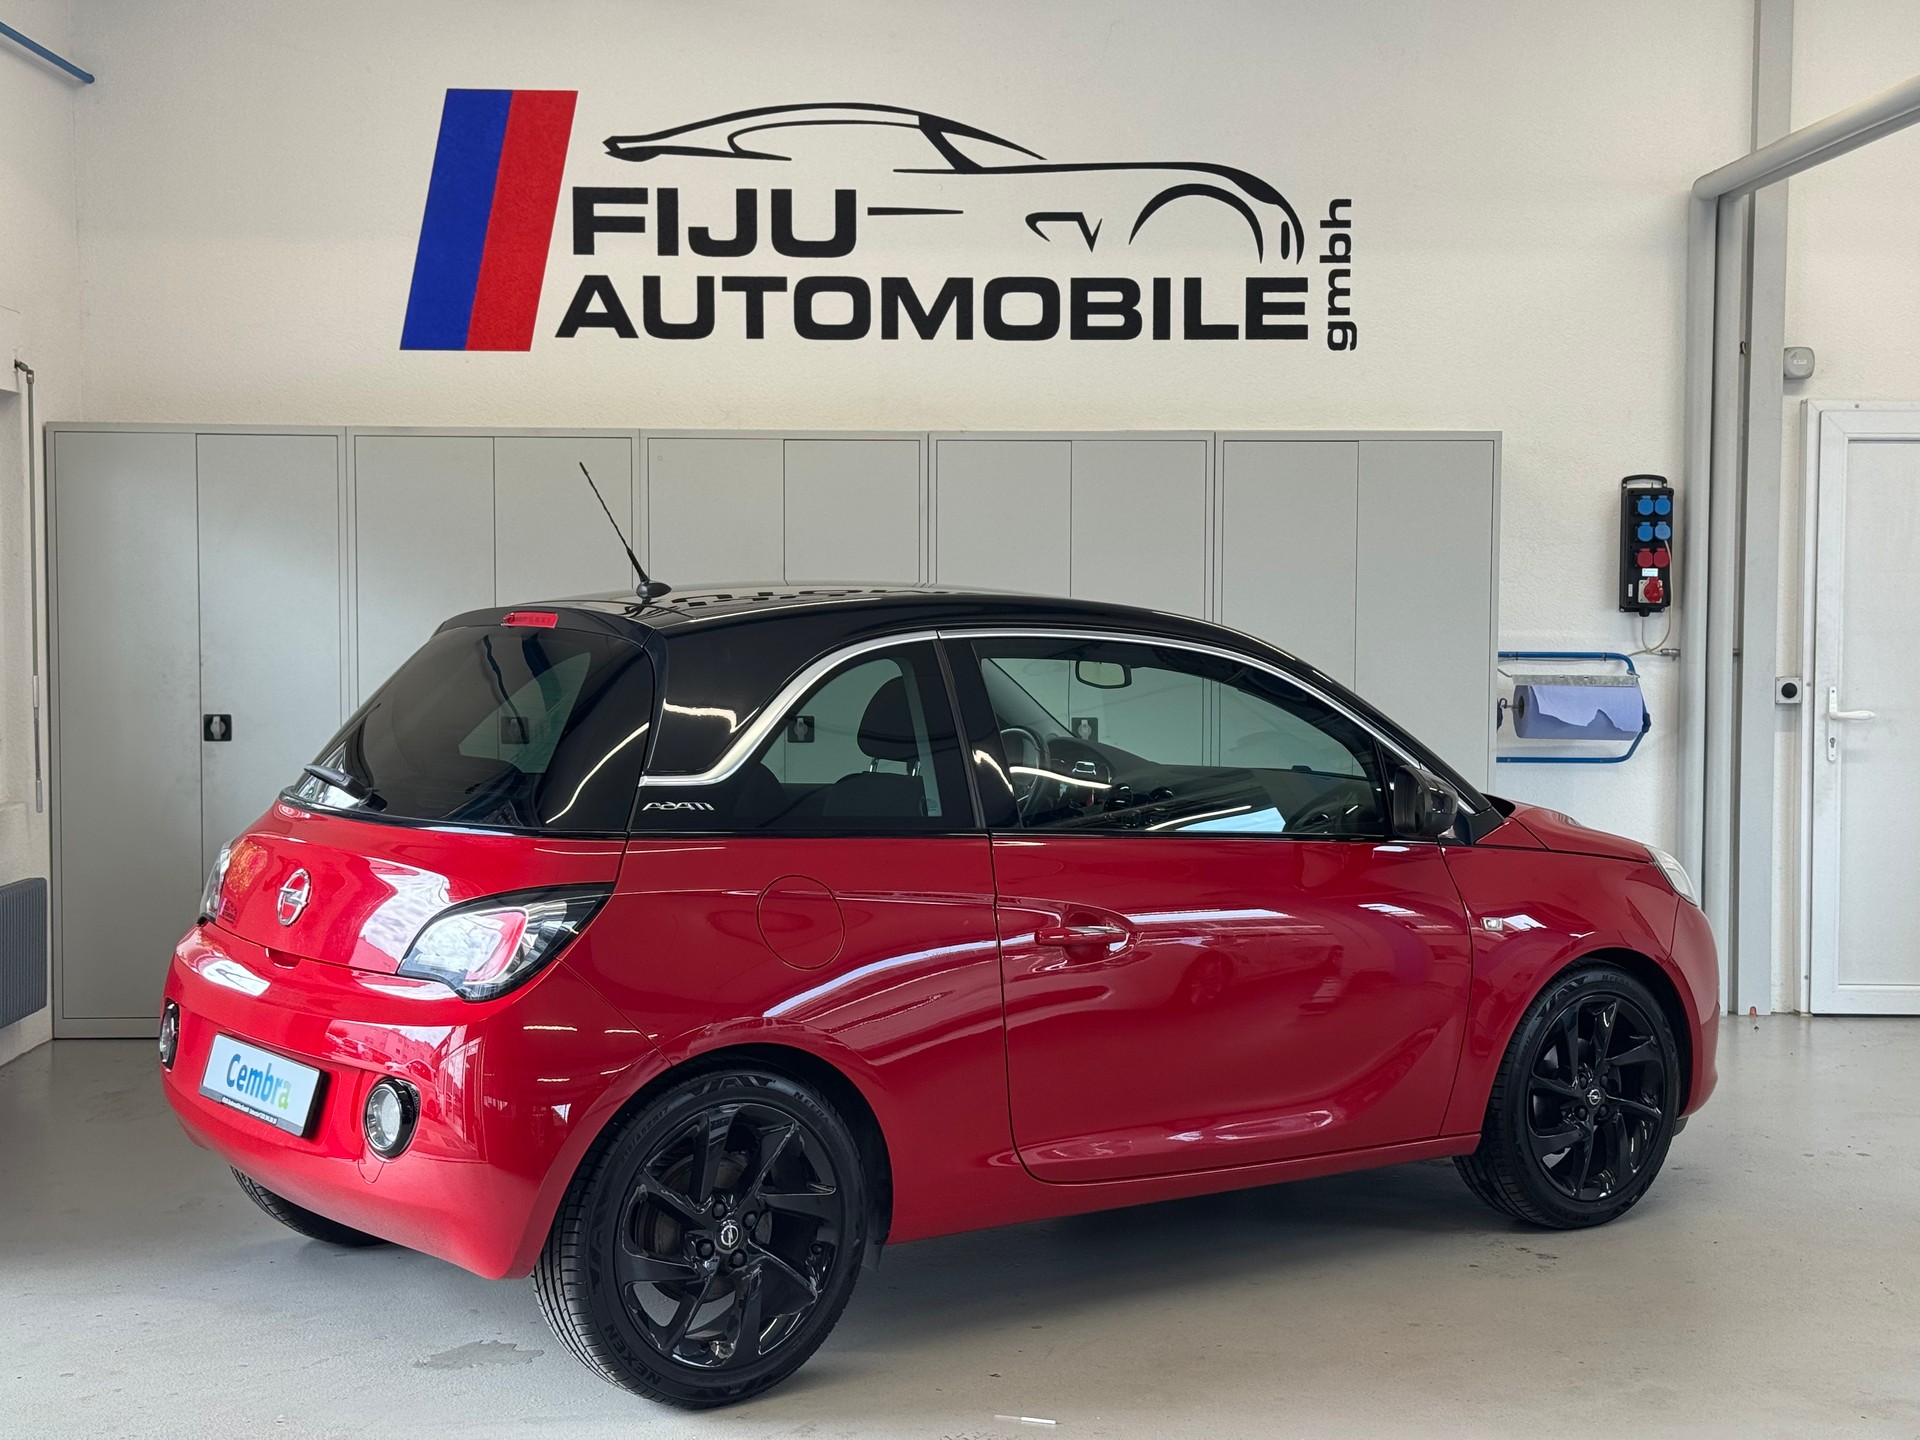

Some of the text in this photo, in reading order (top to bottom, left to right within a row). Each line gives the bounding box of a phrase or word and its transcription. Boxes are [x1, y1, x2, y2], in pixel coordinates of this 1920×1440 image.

[572, 186, 857, 258] FIJU
[554, 274, 1309, 342] AUTOMOBILE
[1319, 198, 1358, 351] gmbh
[226, 1053, 292, 1110] Cembra
[604, 1323, 662, 1385] NEXEN
